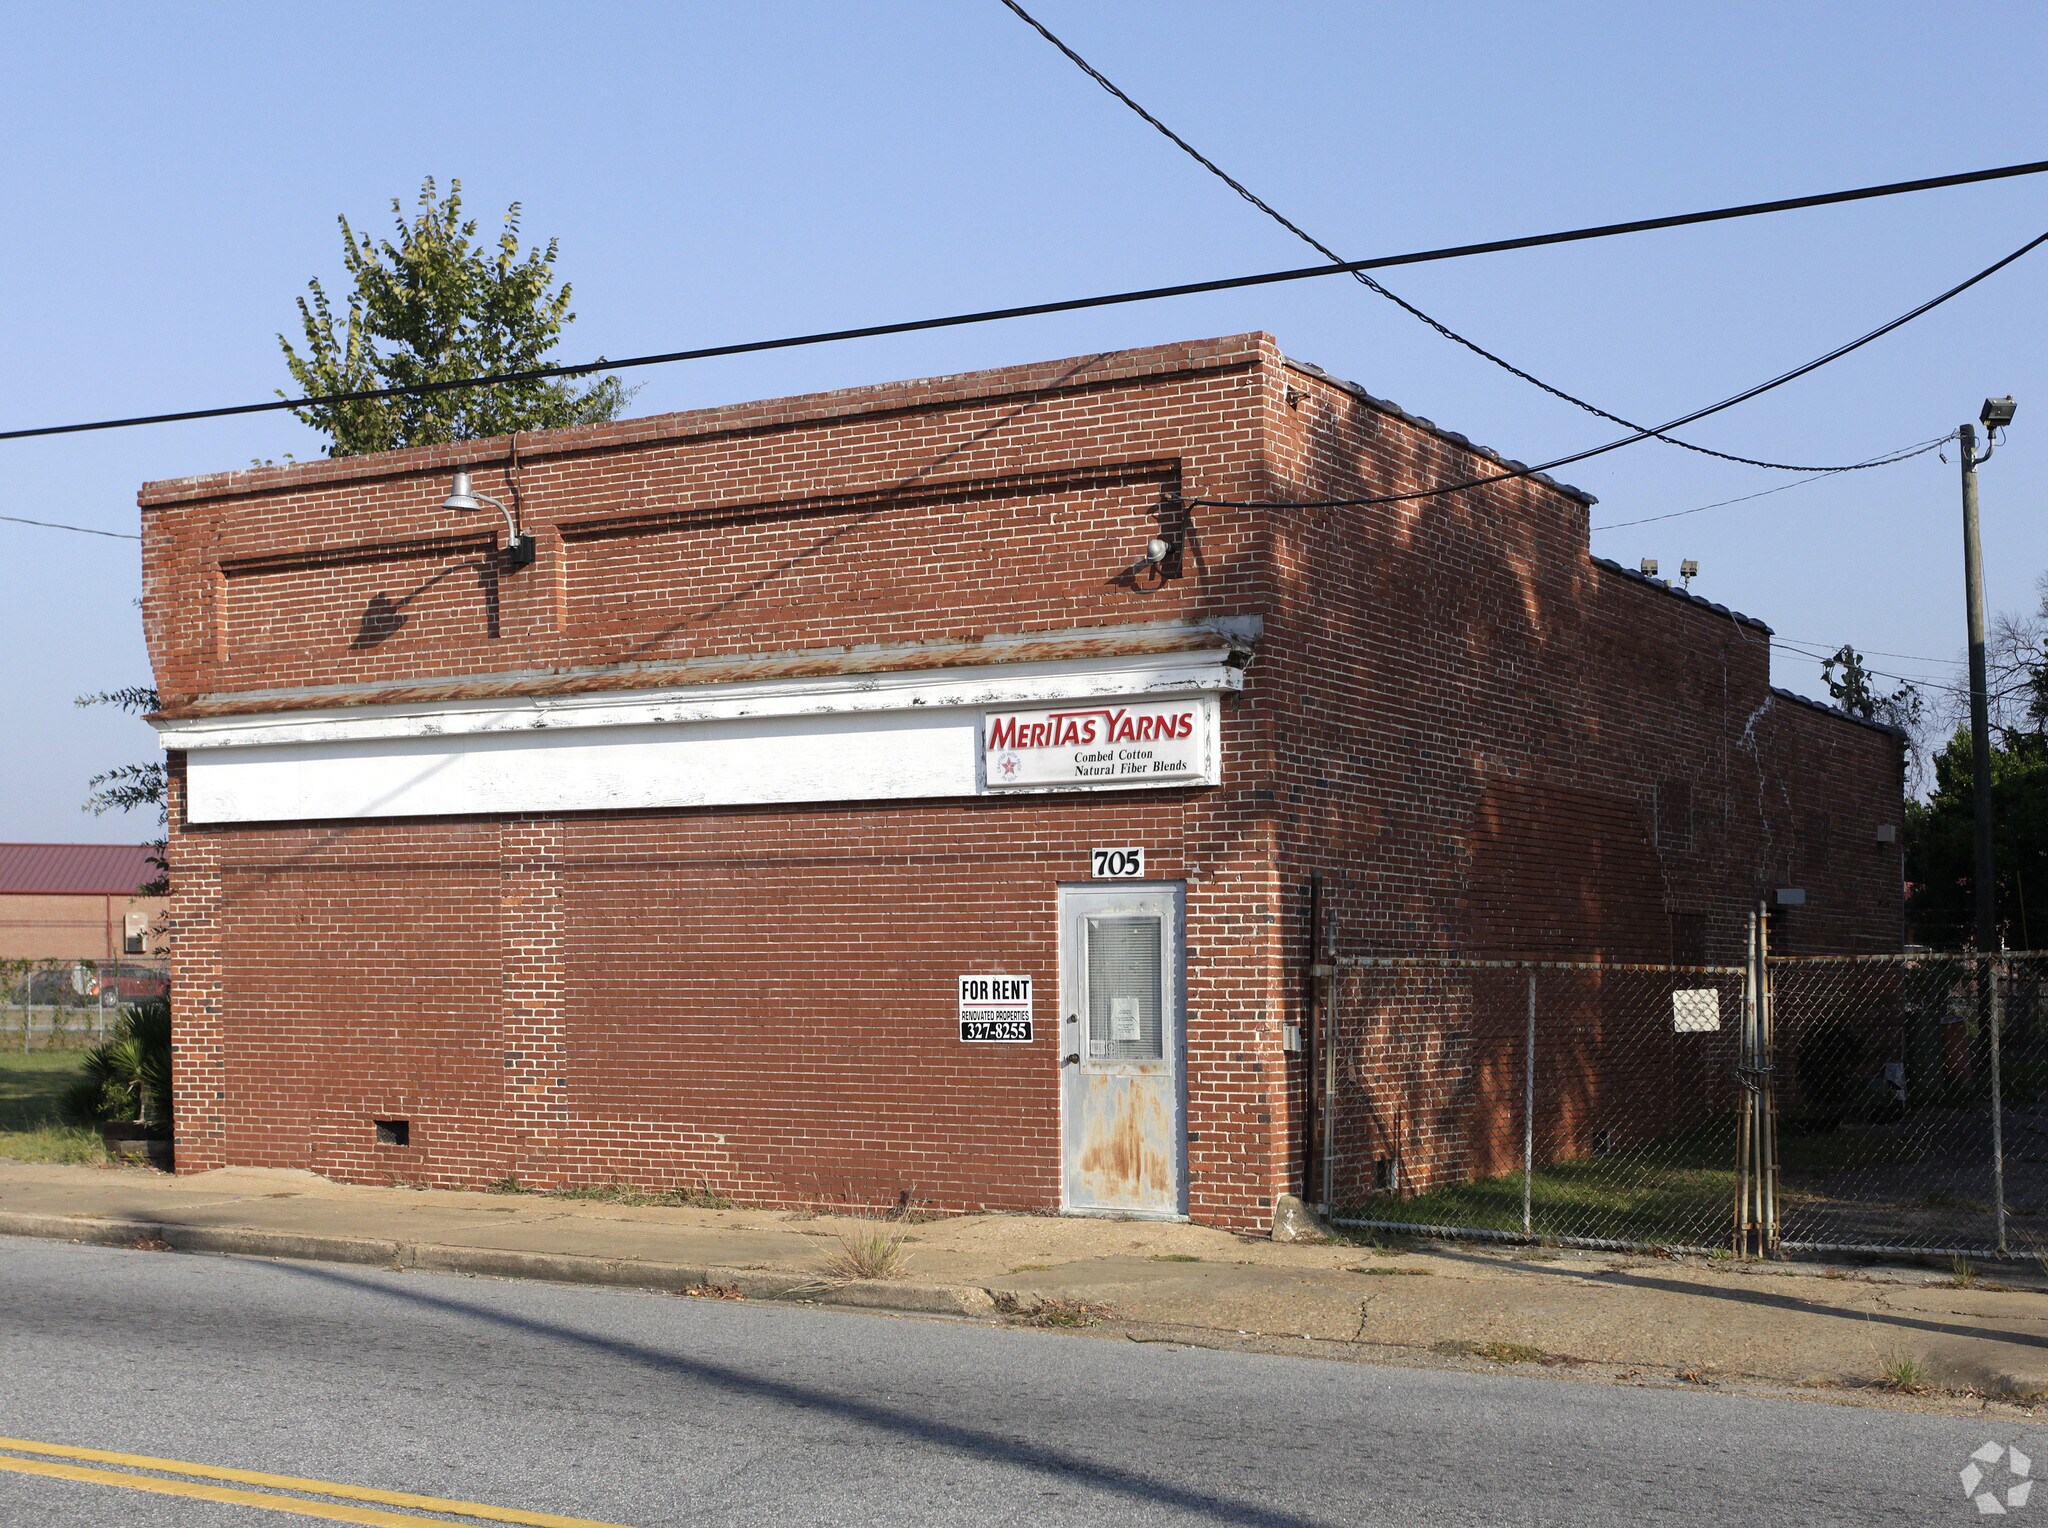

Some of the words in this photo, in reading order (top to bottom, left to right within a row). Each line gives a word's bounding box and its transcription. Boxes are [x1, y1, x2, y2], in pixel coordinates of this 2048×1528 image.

[989, 714, 1096, 750] MERITAS
[1103, 709, 1193, 743] YARNS
[1074, 751, 1113, 763] Combed
[1119, 749, 1153, 761] Cotton
[1074, 764, 1115, 777] Natural
[1120, 762, 1148, 774] Fiber
[1153, 760, 1187, 772] Blends
[1094, 849, 1140, 876] 705
[962, 980, 988, 1000] FOR
[992, 980, 1030, 1000] RENT
[961, 1010, 995, 1021] RENOVATED
[995, 1010, 1030, 1021] PROPERTIES
[967, 1022, 1027, 1039] 327-8255
